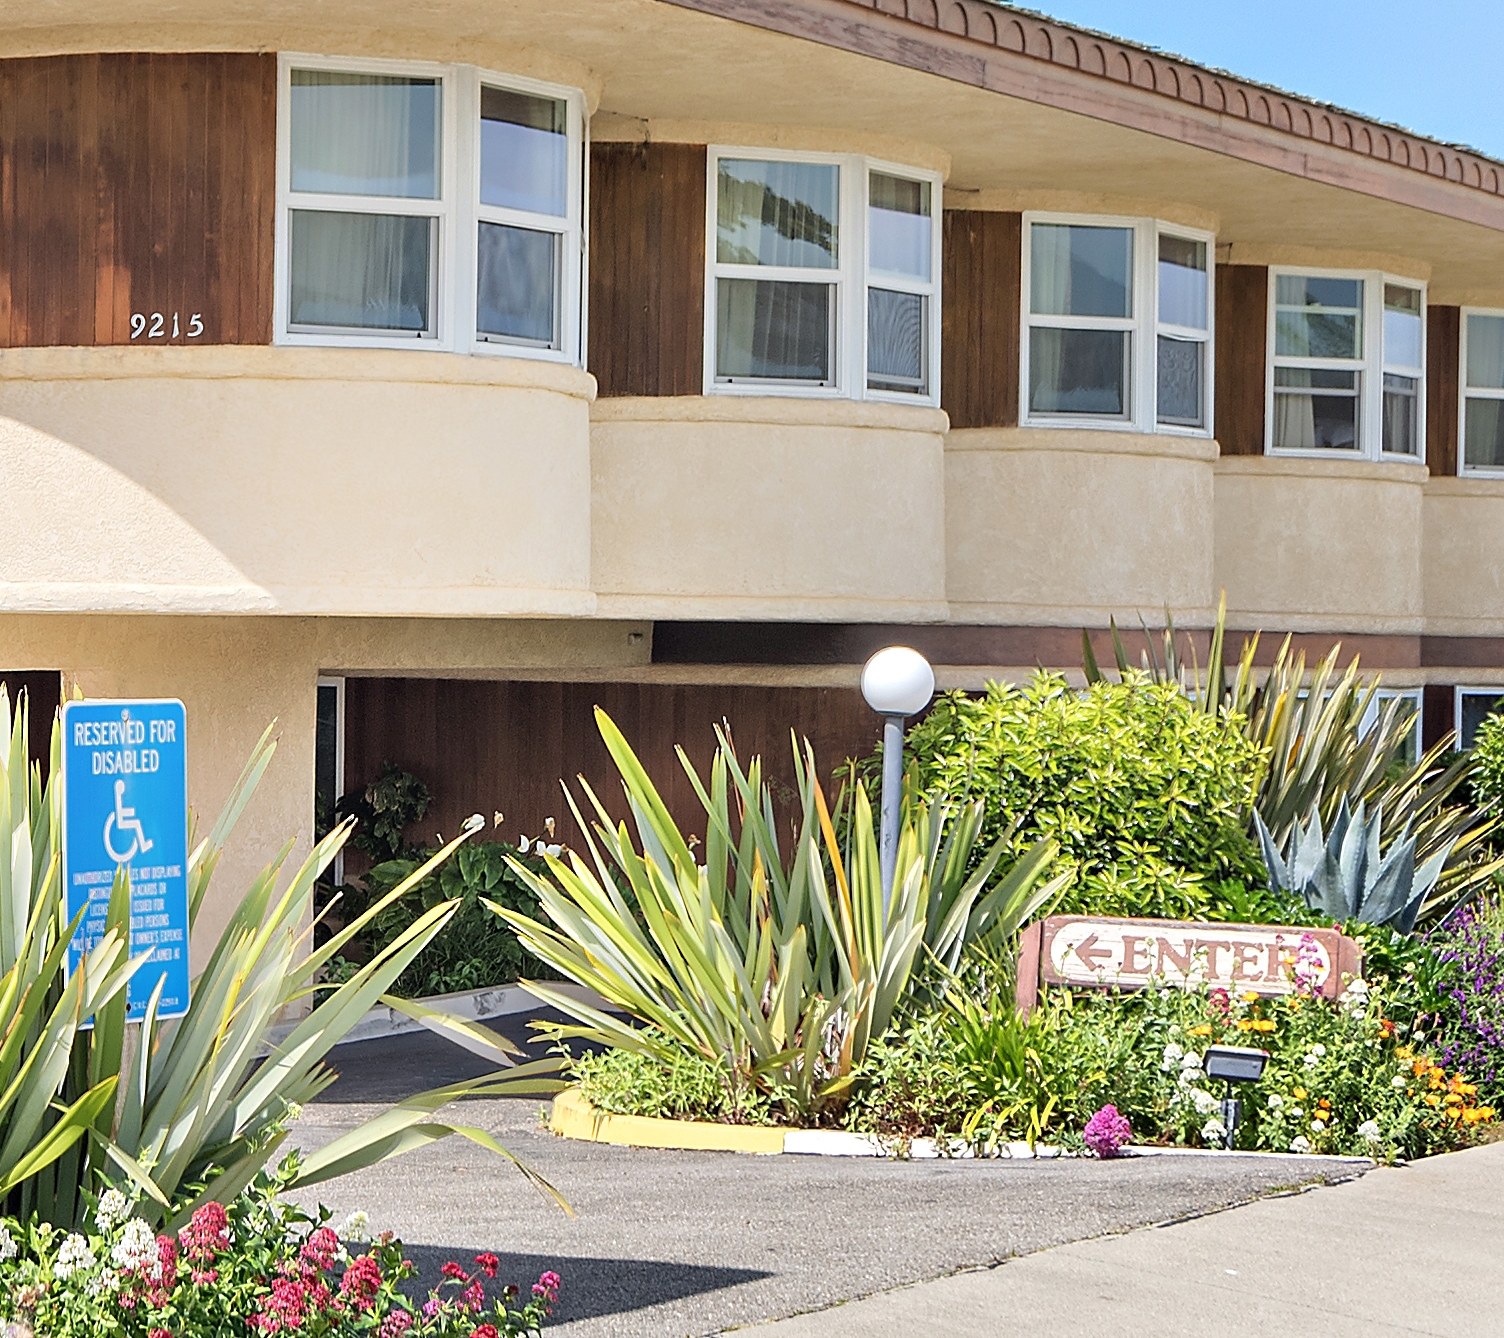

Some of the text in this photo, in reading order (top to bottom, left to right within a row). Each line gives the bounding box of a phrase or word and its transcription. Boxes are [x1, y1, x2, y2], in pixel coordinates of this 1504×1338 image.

[130, 311, 204, 339] 9215
[73, 719, 176, 746] RESERVED FOR
[92, 748, 159, 775] DISABLED
[1120, 935, 1304, 984] ENTER
